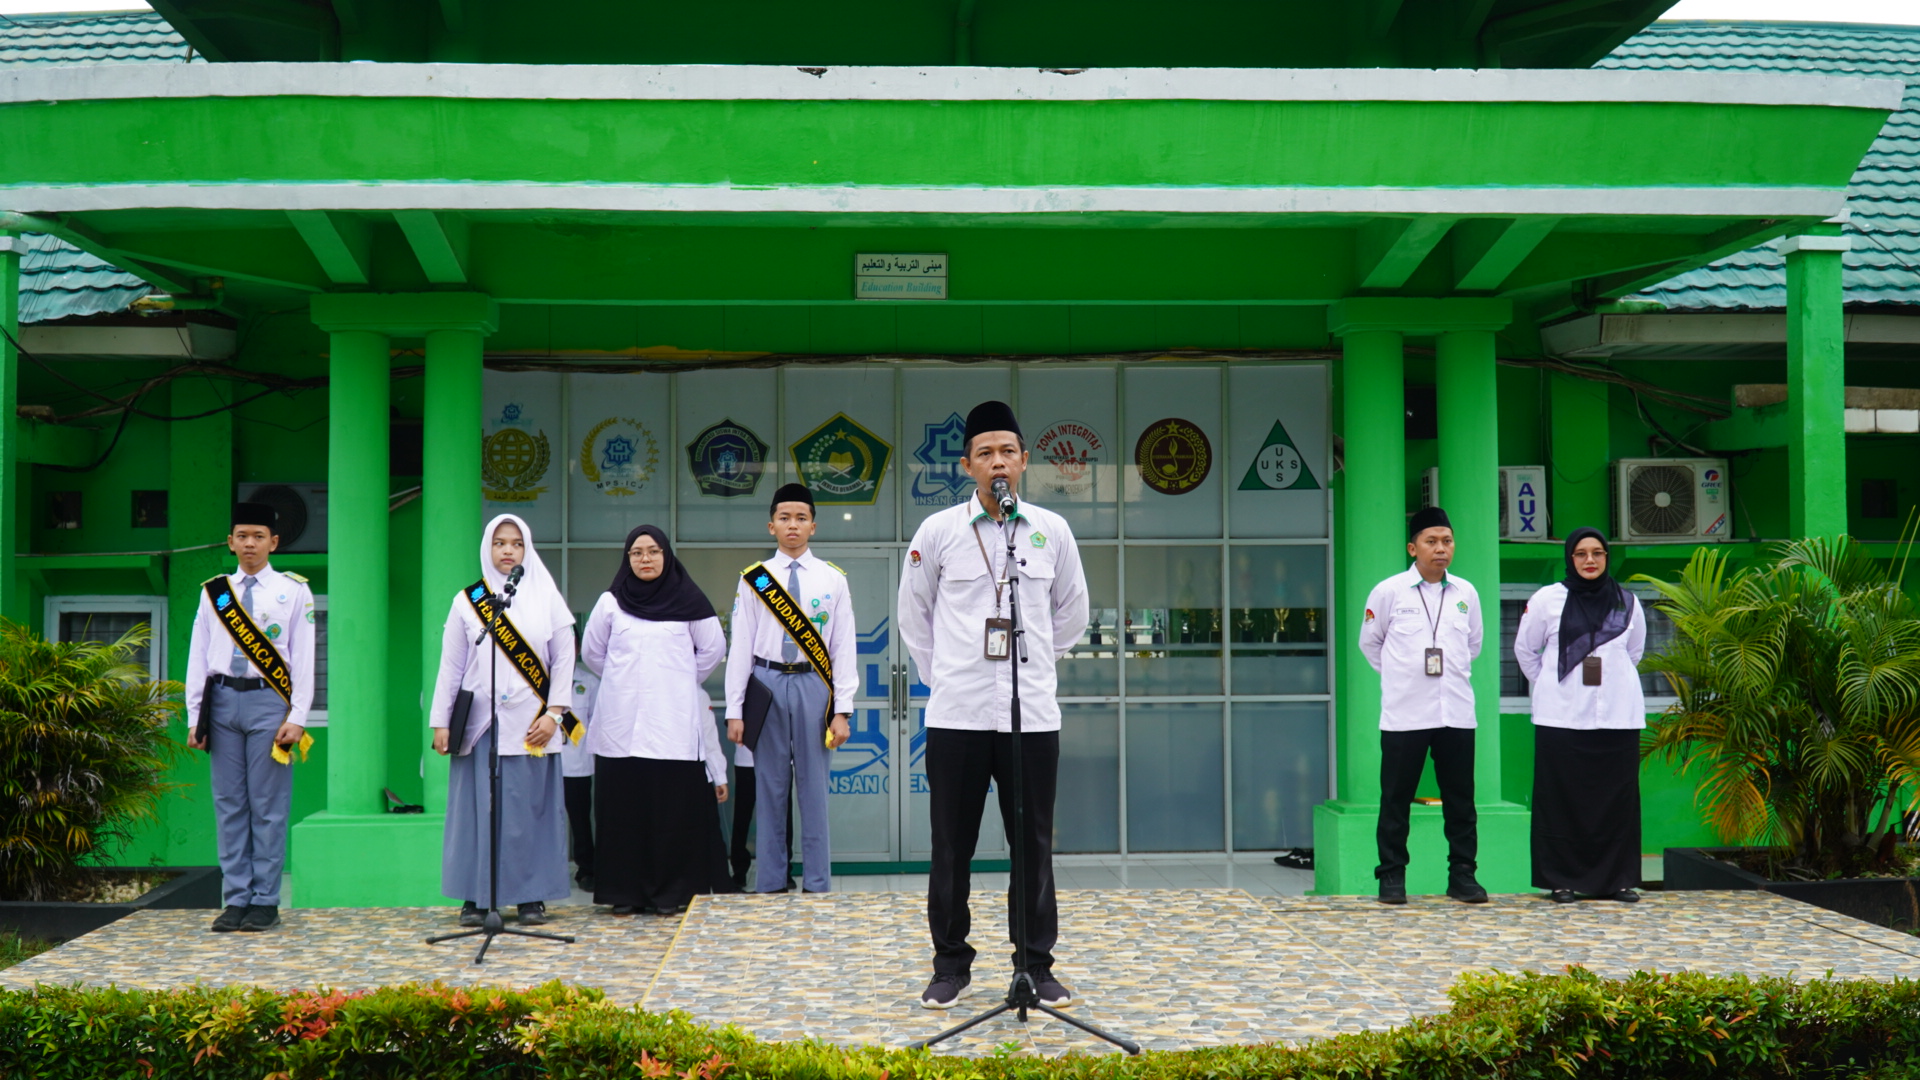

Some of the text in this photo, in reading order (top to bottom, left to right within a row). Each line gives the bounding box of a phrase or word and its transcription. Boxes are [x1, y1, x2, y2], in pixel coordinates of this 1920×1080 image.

[861, 257, 942, 274] مبنى التربية والتعليم
[861, 281, 942, 296] Education Building
[1036, 424, 1102, 452] ZONA INTEGRITAS
[1063, 461, 1080, 474] NO
[821, 480, 839, 492] IKHLAS
[915, 495, 948, 506] INSAN
[1518, 482, 1536, 532] AUX
[225, 608, 274, 669] PEMBACA
[765, 588, 832, 679] AJUDAN PEMBINA
[515, 651, 544, 689] ACARA
[828, 774, 879, 794] NSAN
